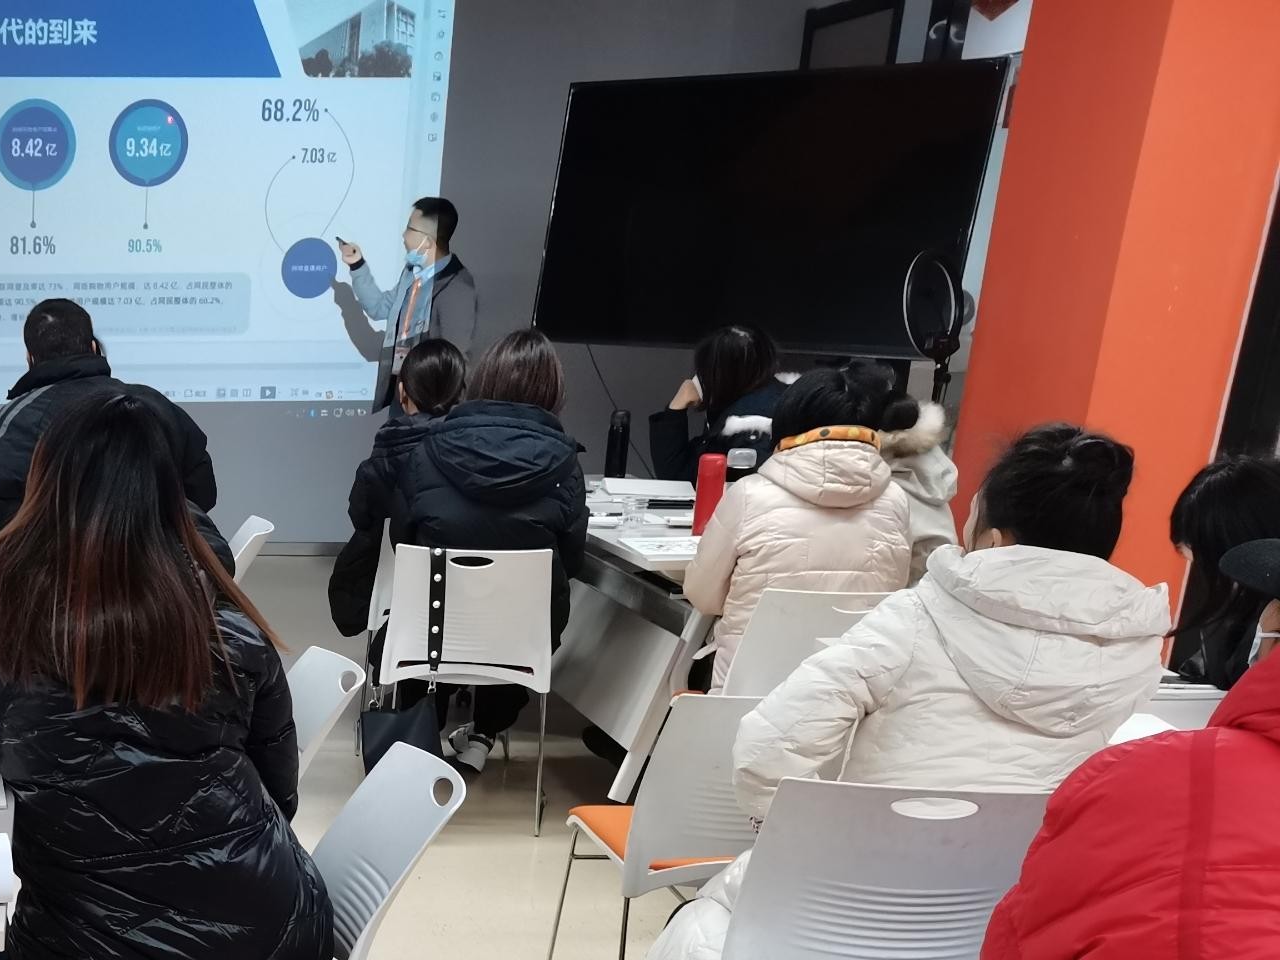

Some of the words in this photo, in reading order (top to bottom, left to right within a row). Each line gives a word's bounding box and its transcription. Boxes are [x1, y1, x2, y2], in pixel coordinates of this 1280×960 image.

[261, 98, 320, 122] 68.2%
[11, 138, 42, 157] 8.42
[45, 143, 58, 157] 亿
[126, 138, 158, 157] 9.34
[159, 143, 172, 157] 亿
[301, 147, 325, 164] 7.03
[326, 151, 337, 163] 亿
[10, 236, 56, 255] 81.6%
[127, 238, 162, 252] 90.5%
